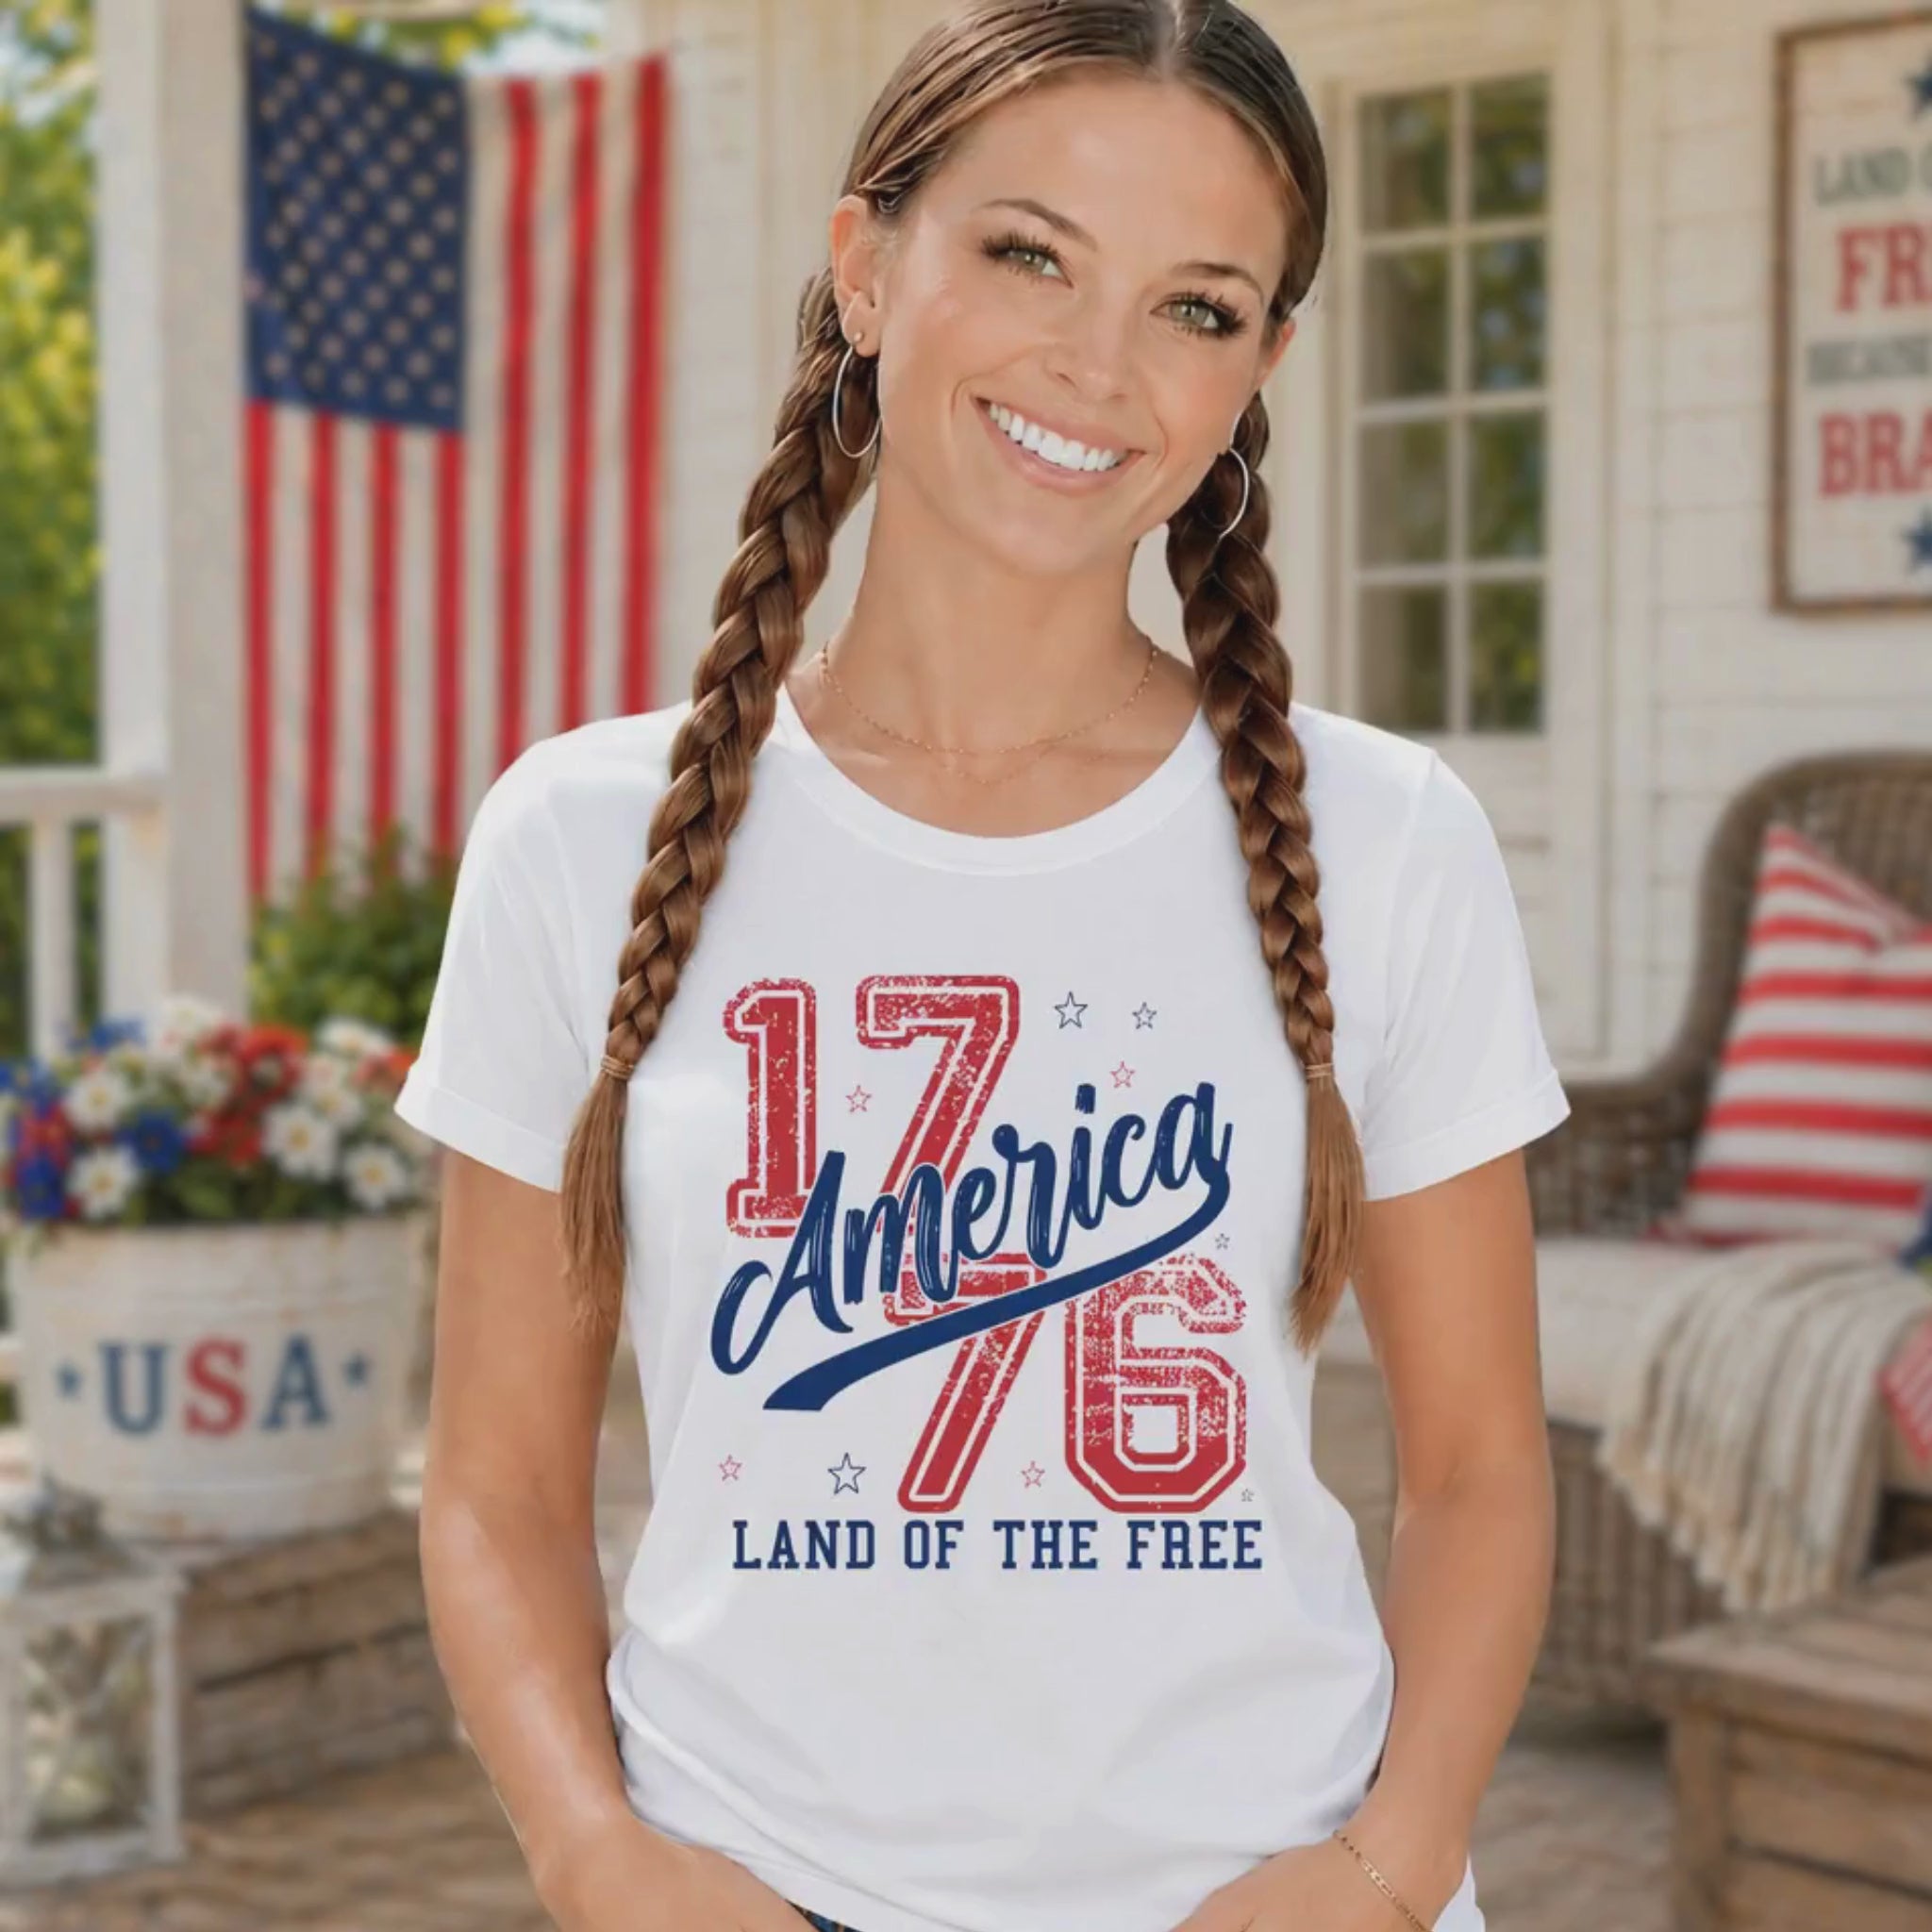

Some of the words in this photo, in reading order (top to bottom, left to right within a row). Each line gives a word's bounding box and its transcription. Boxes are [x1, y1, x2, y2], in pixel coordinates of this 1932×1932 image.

[710, 1082, 1233, 1377] America
[724, 975, 1020, 1238] 17
[97, 1333, 333, 1440] USA
[883, 1252, 1246, 1514] 76
[732, 1520, 875, 1570] LAND
[903, 1520, 964, 1570] OF
[993, 1520, 1098, 1570] THE
[1126, 1520, 1263, 1570] FREE
